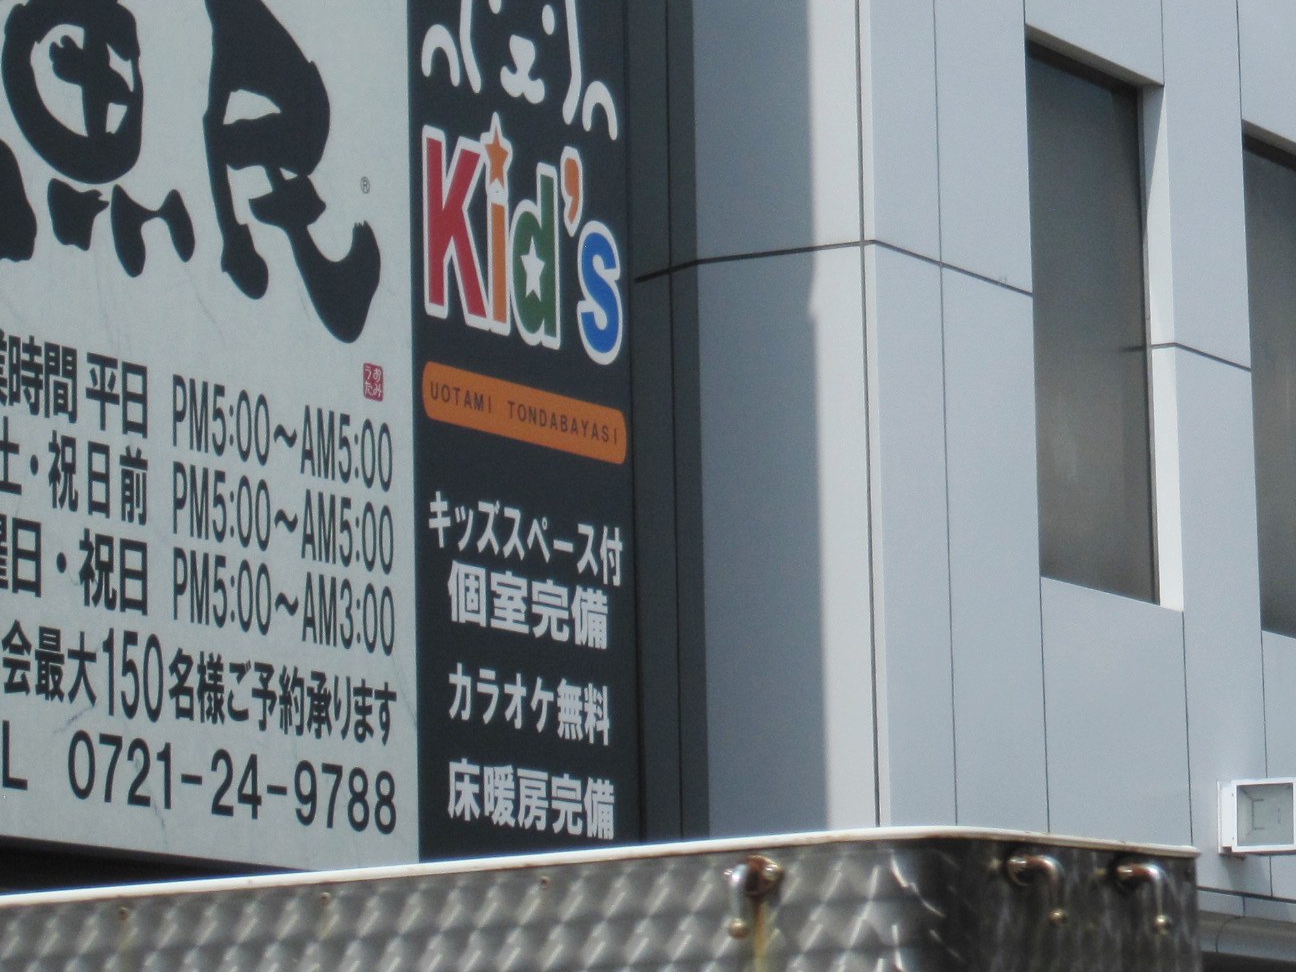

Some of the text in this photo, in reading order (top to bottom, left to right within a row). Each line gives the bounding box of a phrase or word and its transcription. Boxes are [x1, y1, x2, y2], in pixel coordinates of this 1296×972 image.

[422, 111, 623, 365] Kid's
[0, 330, 78, 424] 時間
[85, 352, 148, 439] 平日
[430, 381, 618, 444] UOTAMI TONDABAYASI
[0, 513, 148, 616] 日・祝日
[428, 491, 623, 587] キッズスペース付
[448, 560, 608, 650] 個室完備
[448, 662, 610, 746] カラオケ無料
[68, 730, 397, 835] 0721-24-9788
[448, 758, 615, 841] 床暖房完備
